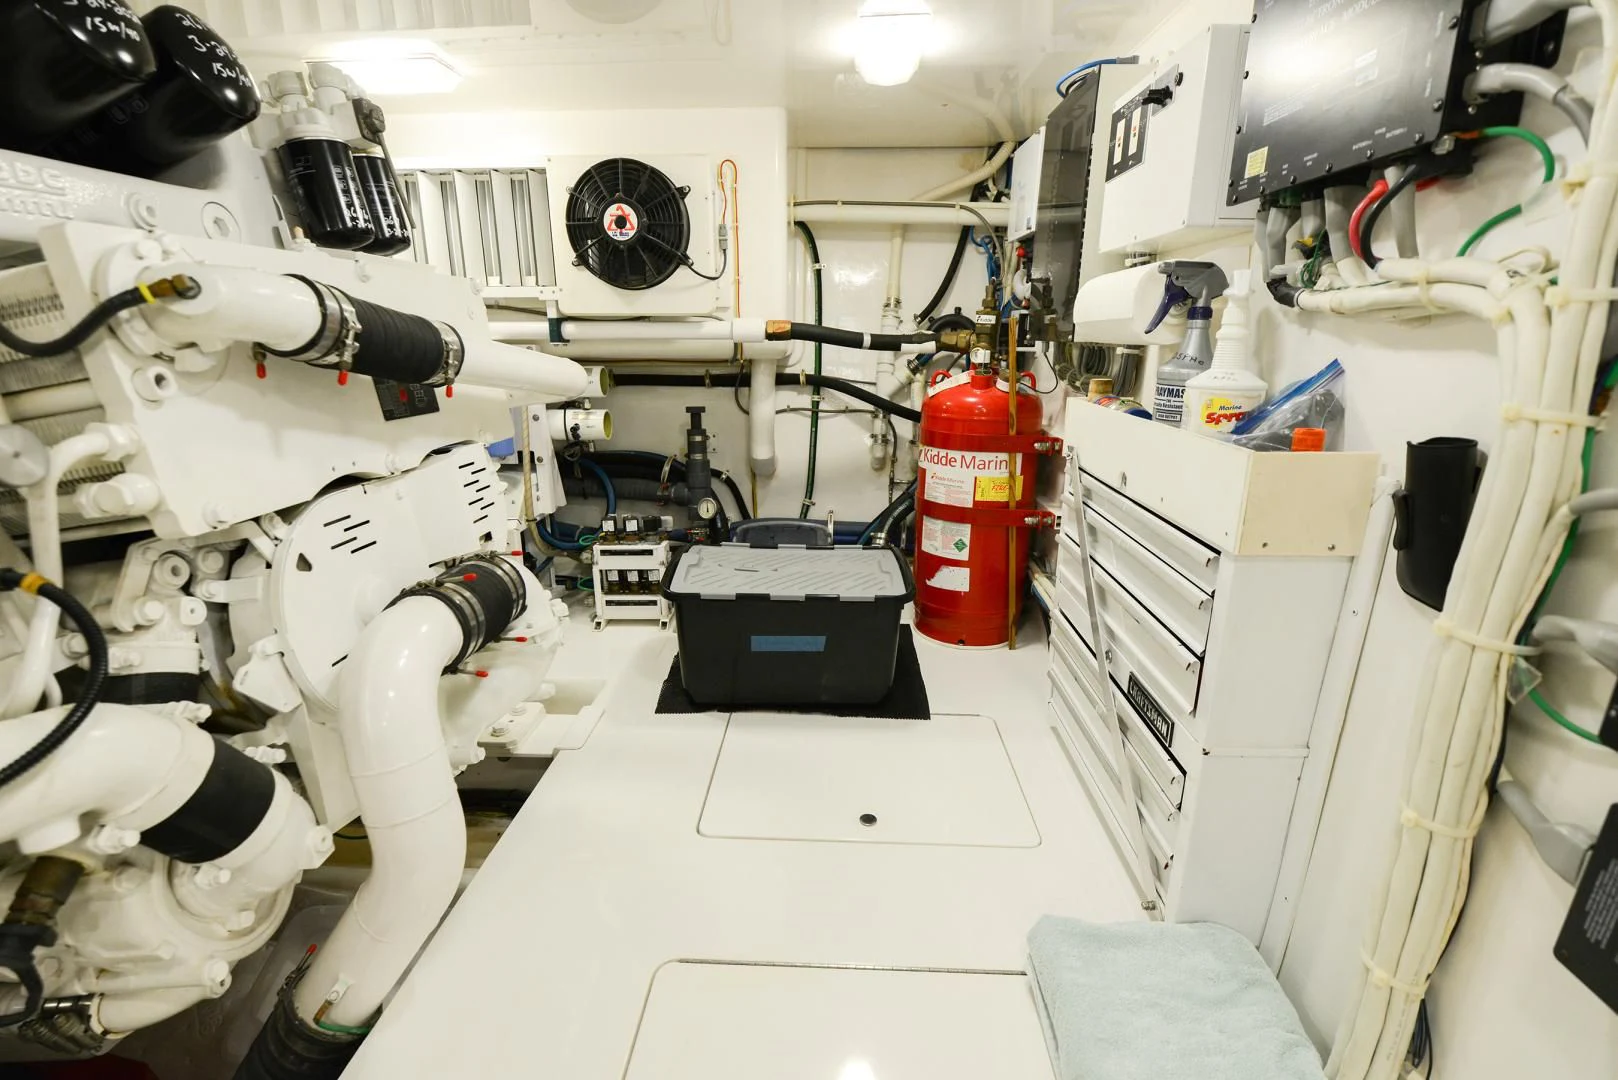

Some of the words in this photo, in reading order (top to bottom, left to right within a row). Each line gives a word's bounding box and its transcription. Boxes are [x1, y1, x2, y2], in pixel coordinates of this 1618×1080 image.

[924, 447, 958, 468] Kidde
[960, 454, 1009, 471] Marin
[1129, 680, 1168, 737] CRAFTSMAN
